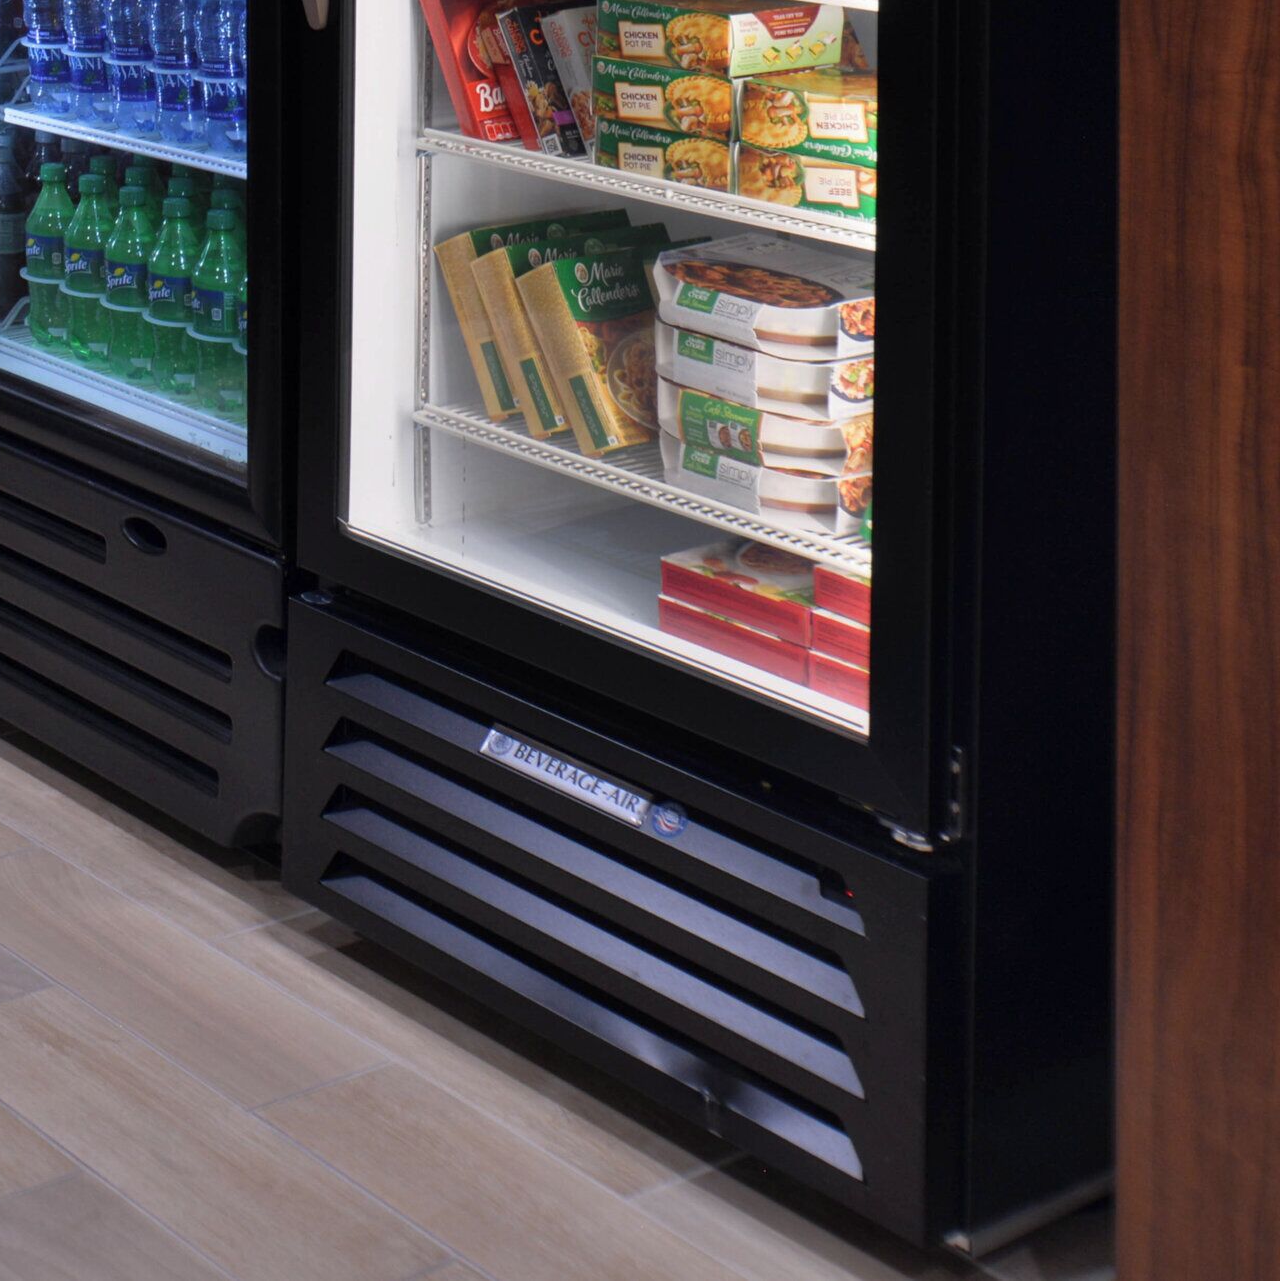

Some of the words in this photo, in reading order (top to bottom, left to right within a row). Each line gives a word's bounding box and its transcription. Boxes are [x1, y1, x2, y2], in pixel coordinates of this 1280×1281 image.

[624, 31, 659, 40] CHICKEN
[625, 40, 639, 48] POT
[641, 40, 653, 48] PIE
[620, 92, 658, 101] CHICKEN
[622, 102, 637, 110] POT
[639, 102, 650, 110] PIE
[816, 121, 860, 131] CHICKEN
[623, 153, 658, 162] CHICKEN
[624, 161, 638, 169] POT
[640, 162, 652, 170] PIE
[829, 187, 852, 197] BEEF
[65, 258, 88, 273] Sprite
[107, 270, 134, 288] Sprite
[583, 262, 624, 287] Marie
[149, 286, 171, 302] Sprite
[717, 299, 754, 320] simply
[715, 349, 754, 372] simply
[719, 462, 754, 486] simply
[514, 743, 641, 814] BEVERAGE-AIR
